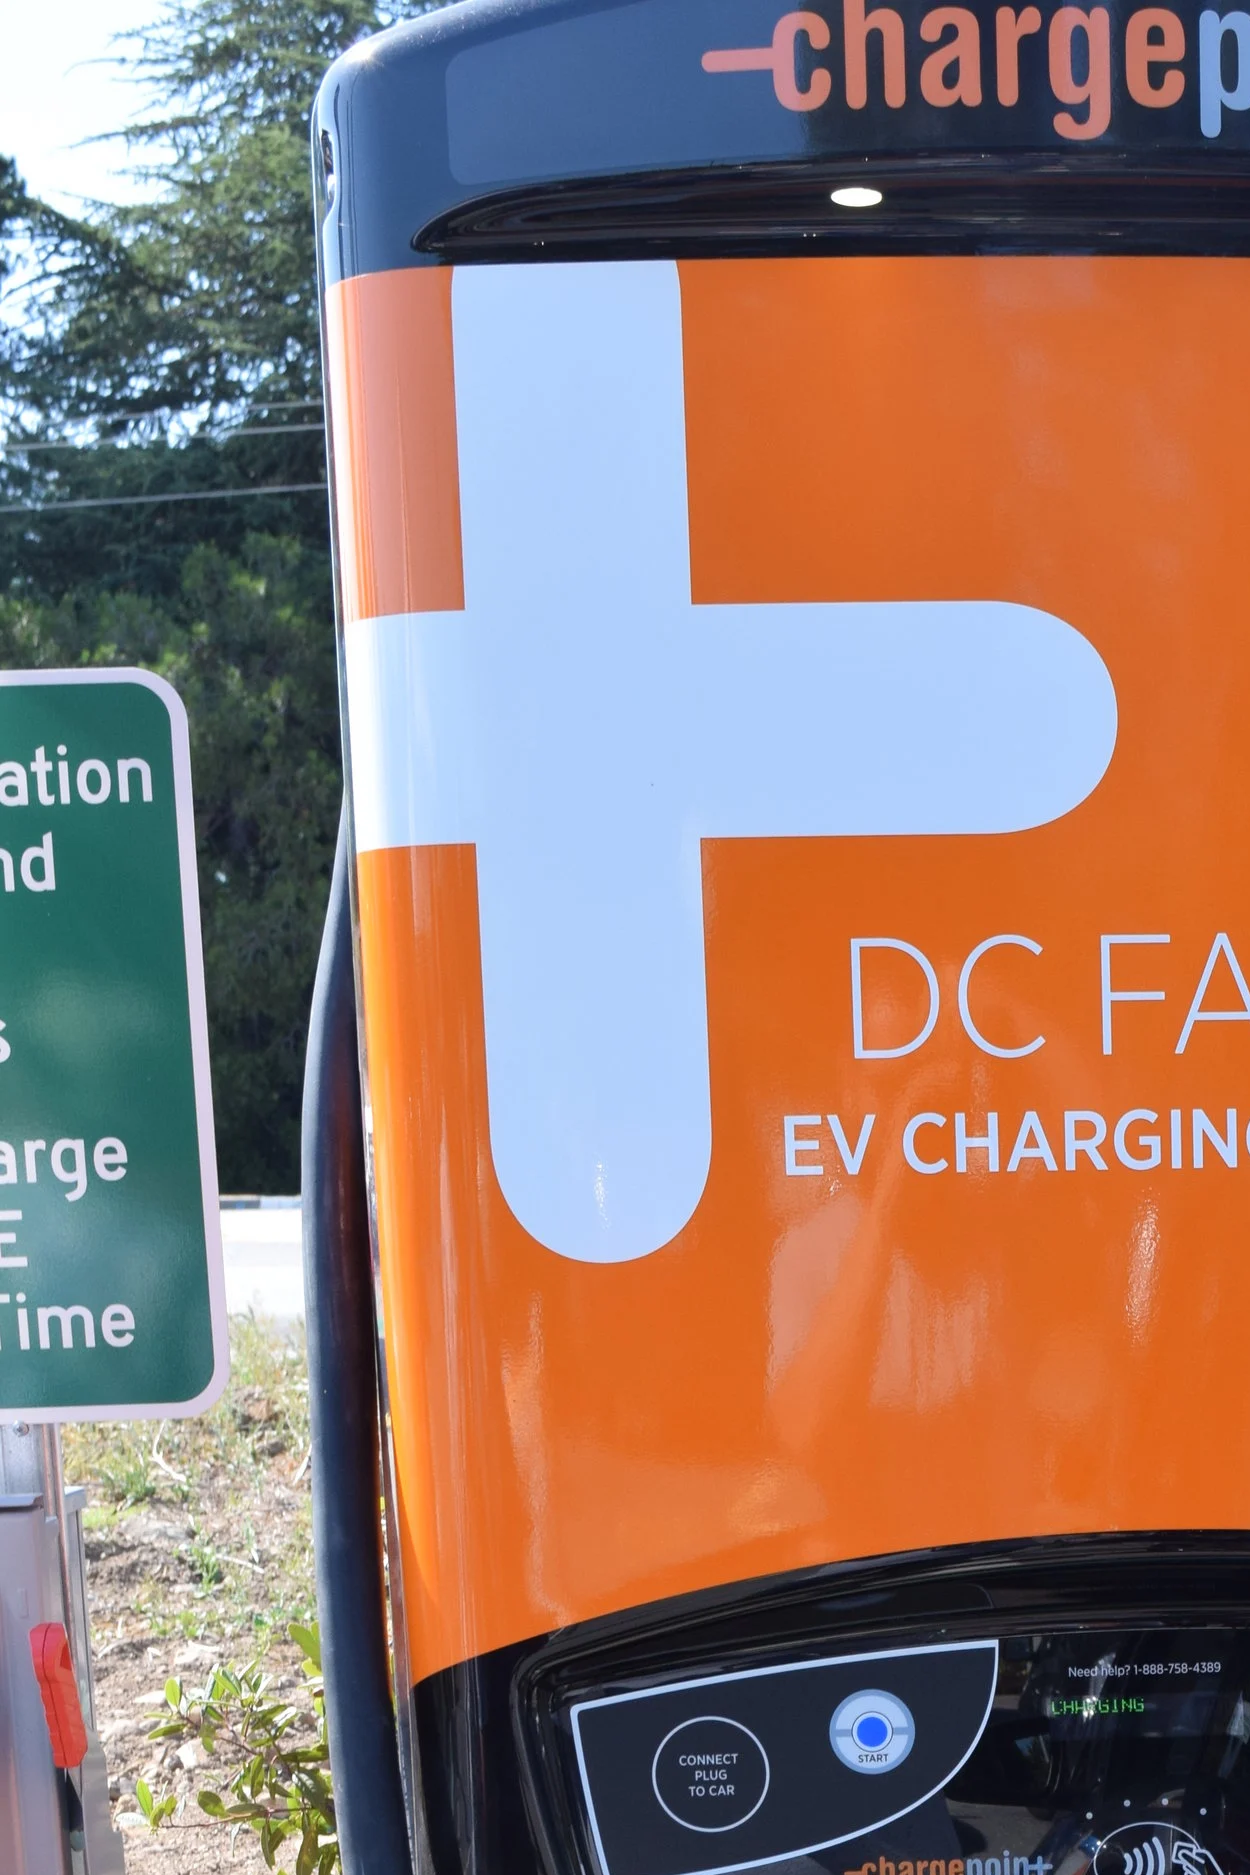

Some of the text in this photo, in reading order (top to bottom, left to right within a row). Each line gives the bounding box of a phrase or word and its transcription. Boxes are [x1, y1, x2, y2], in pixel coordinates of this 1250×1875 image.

[0, 744, 153, 807] ation
[850, 933, 1047, 1060] DC
[783, 1114, 877, 1177] EV
[1068, 1661, 1222, 1679] Need help? 1-888-758-4389
[1051, 1698, 1145, 1716] CHARGING
[679, 1753, 739, 1766] CONNECT
[858, 1753, 889, 1763] START
[695, 1770, 728, 1782] PLUG
[688, 1785, 735, 1797] TO CAR
